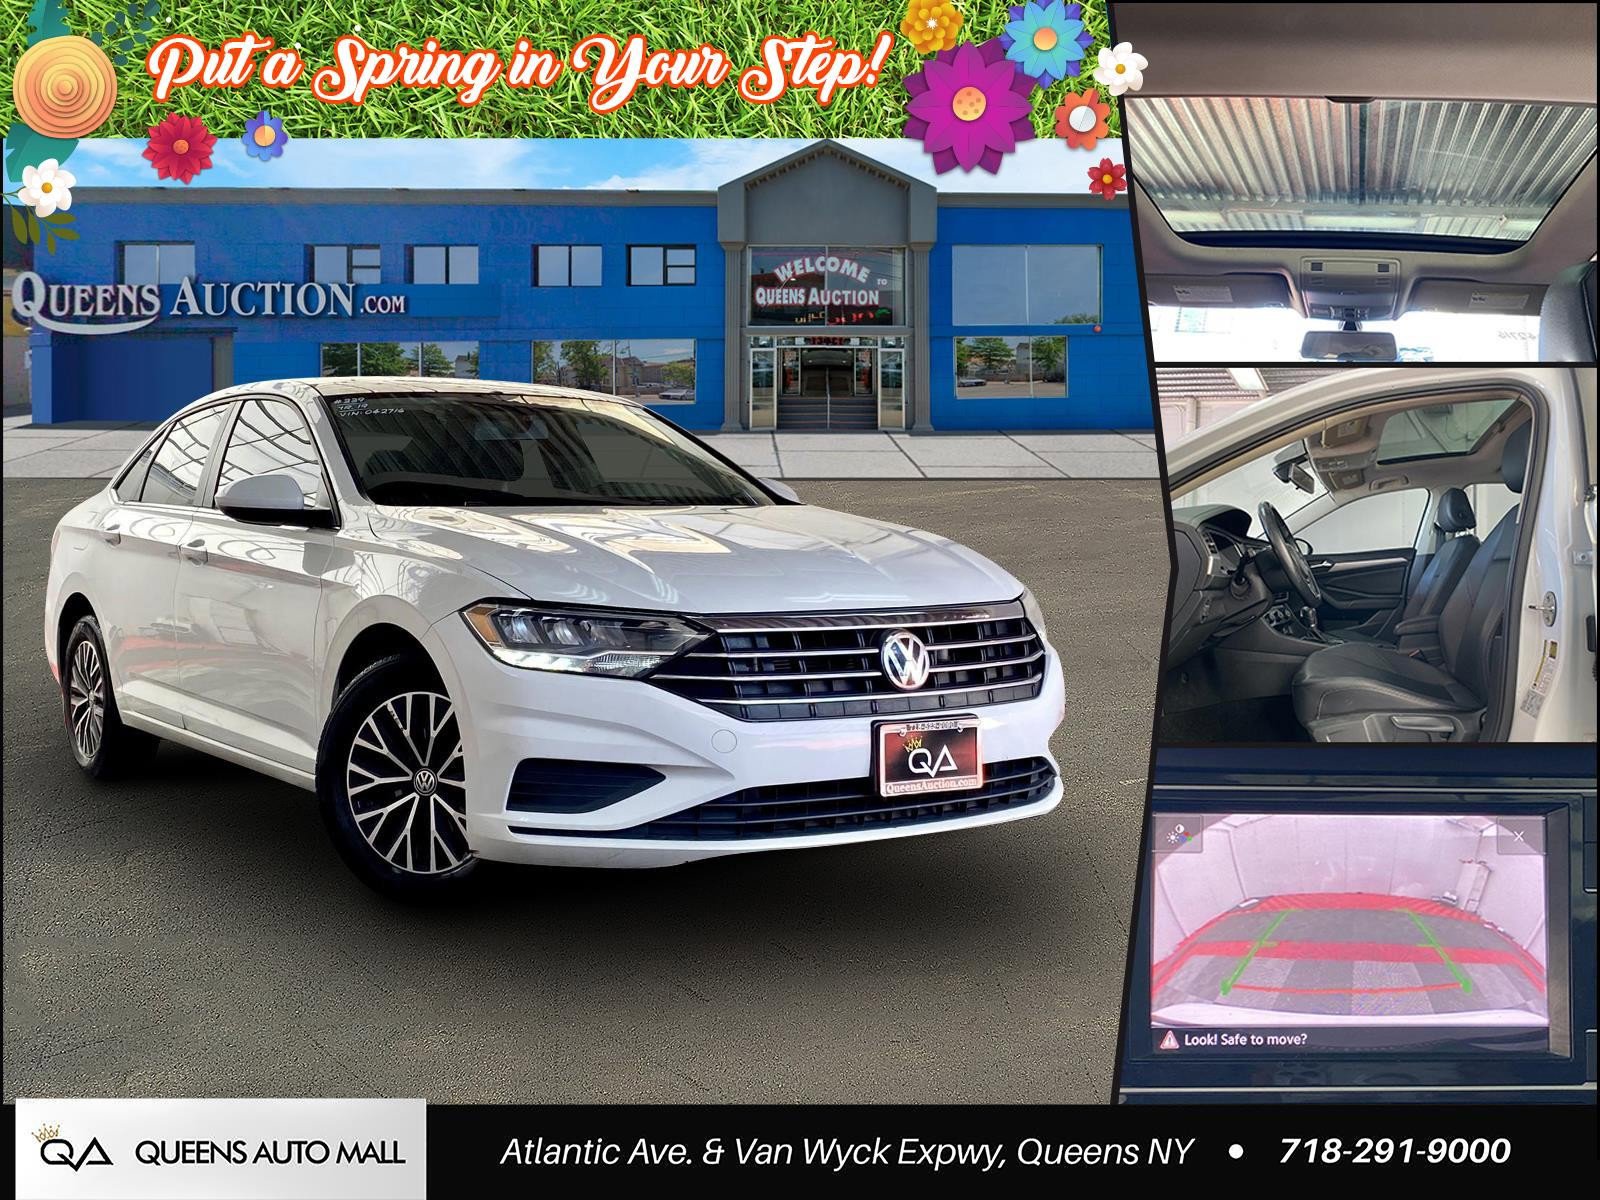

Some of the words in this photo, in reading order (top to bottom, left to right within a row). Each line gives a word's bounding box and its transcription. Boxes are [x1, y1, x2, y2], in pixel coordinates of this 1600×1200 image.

[774, 256, 870, 283] WELCOME
[11, 271, 161, 335] QUEENS
[755, 287, 805, 306] QUEENS
[808, 287, 879, 306] AUCTION
[886, 778, 978, 794] QueensAuction.com
[1184, 1033, 1218, 1046] Look!
[1220, 1033, 1248, 1046] Safe
[1250, 1034, 1264, 1046] to
[1266, 1033, 1308, 1046] move?
